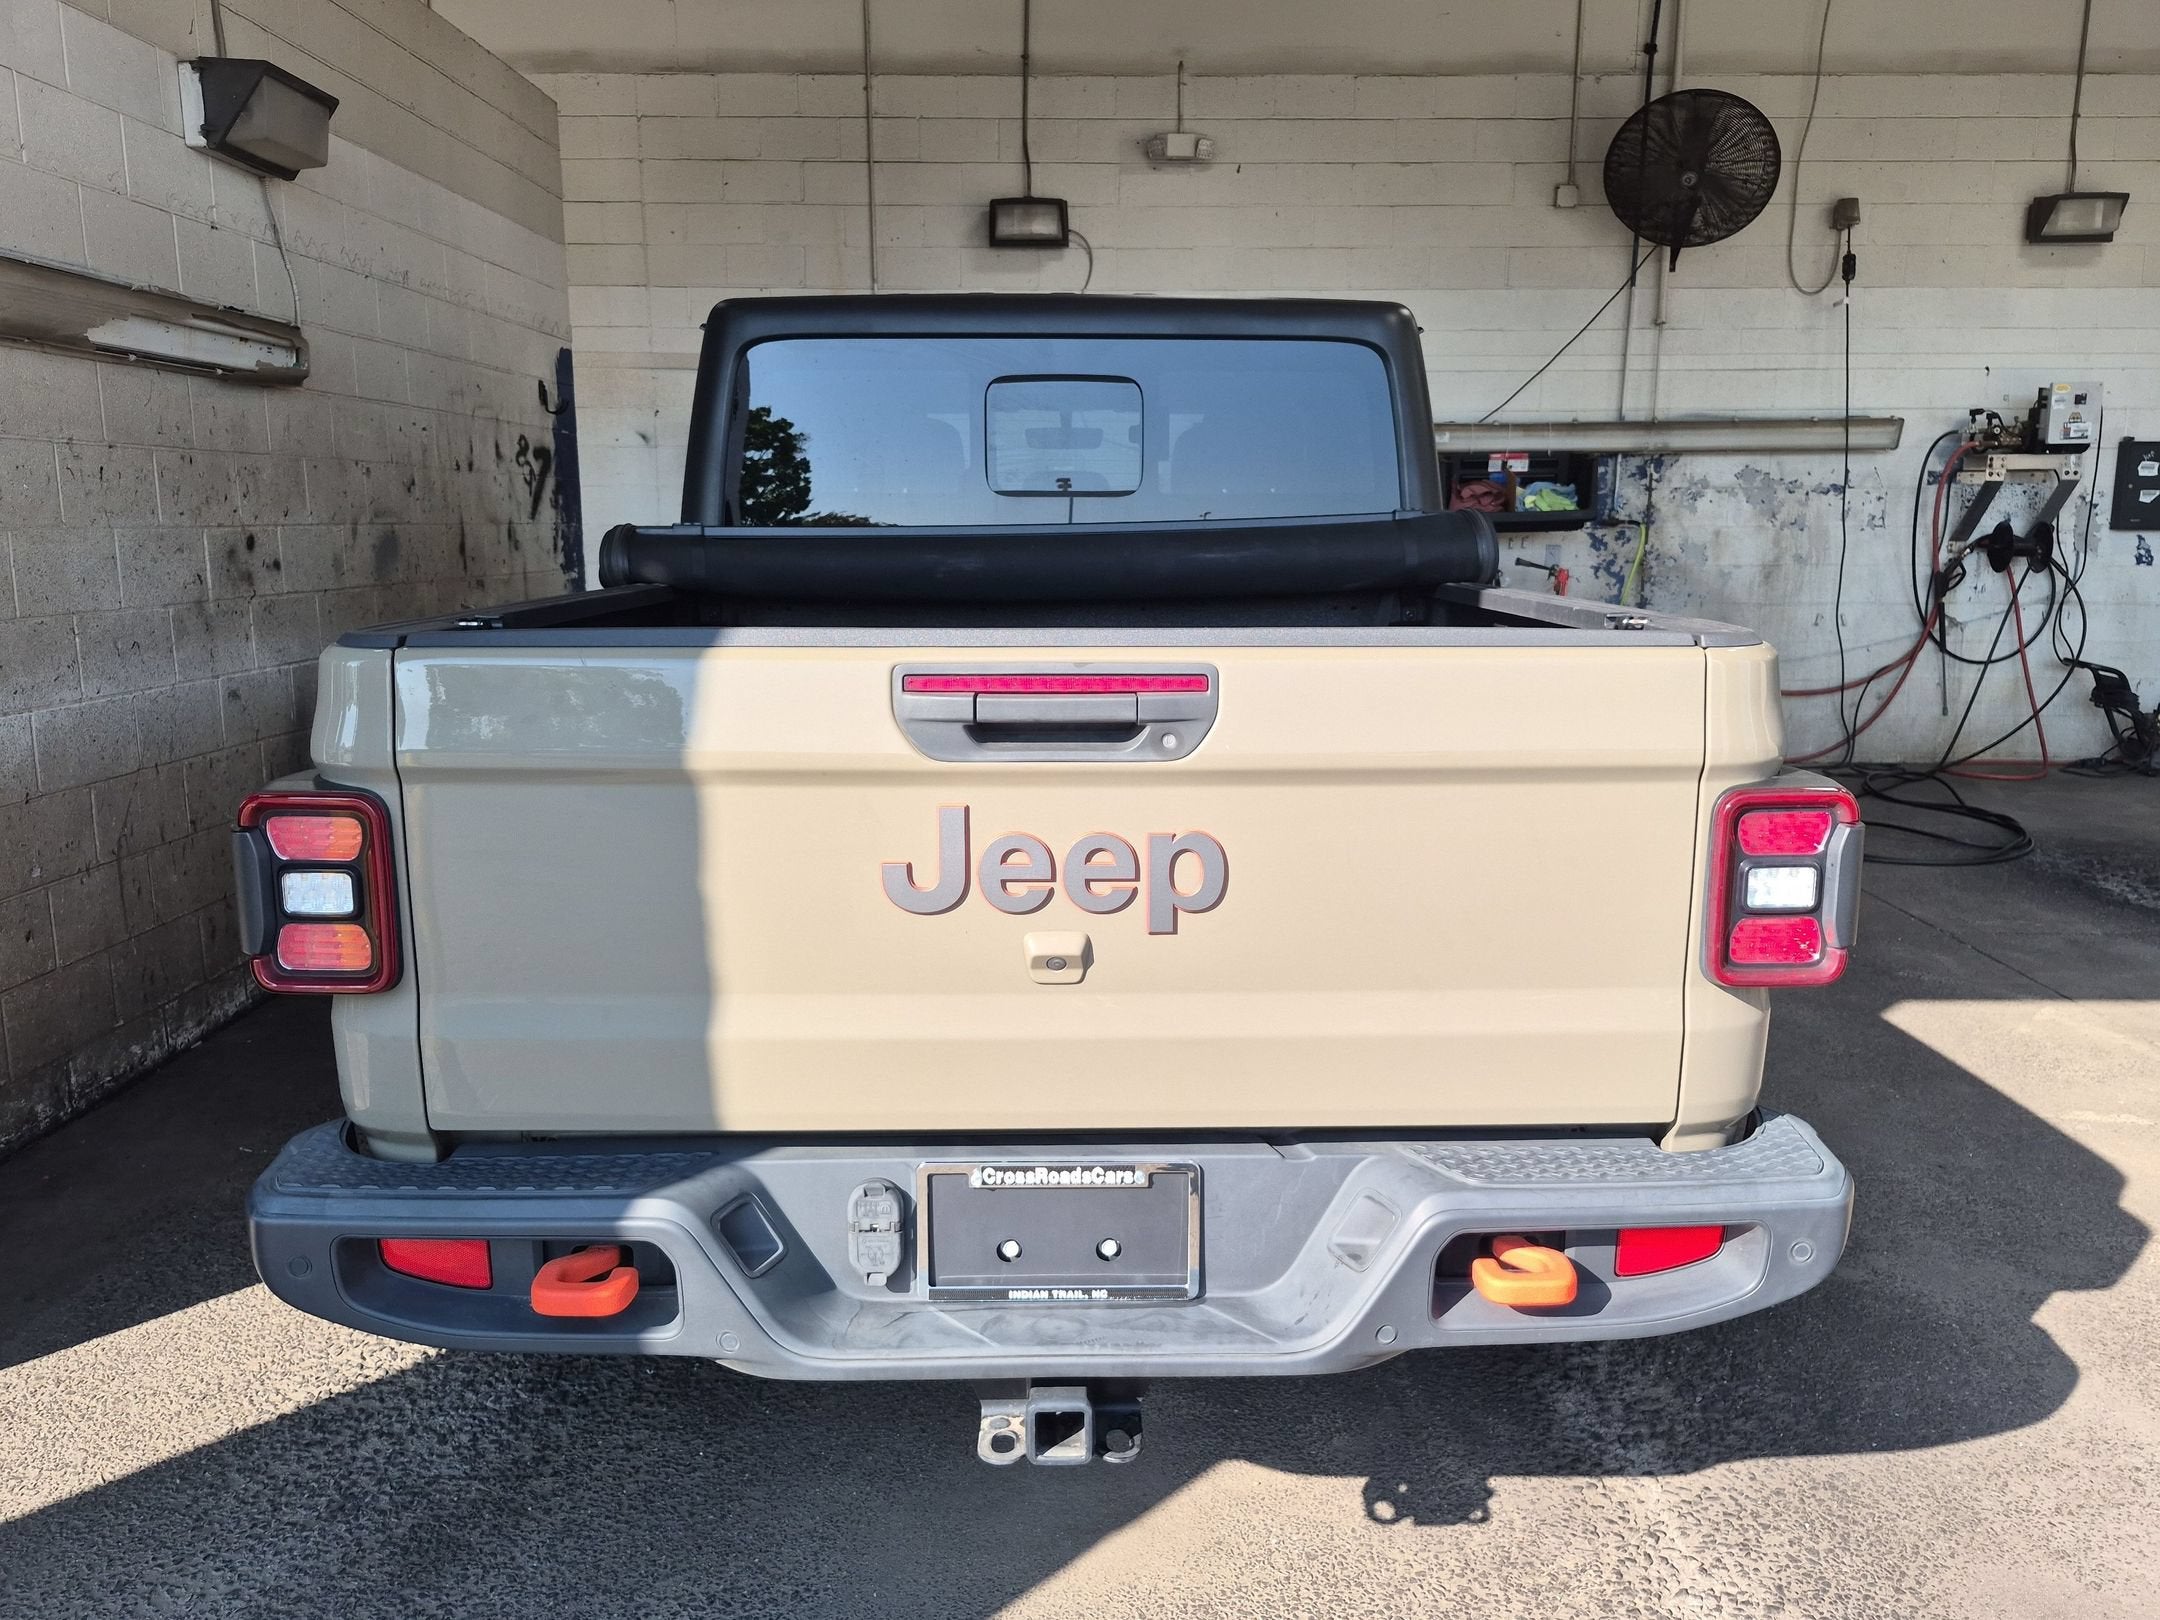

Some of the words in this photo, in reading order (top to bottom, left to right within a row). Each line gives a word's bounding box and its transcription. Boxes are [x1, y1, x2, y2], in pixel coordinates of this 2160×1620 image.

[881, 804, 1229, 935] Jeep
[982, 1166, 1135, 1185] CrossRoadsCars
[1008, 1289, 1048, 1300] INDIAN
